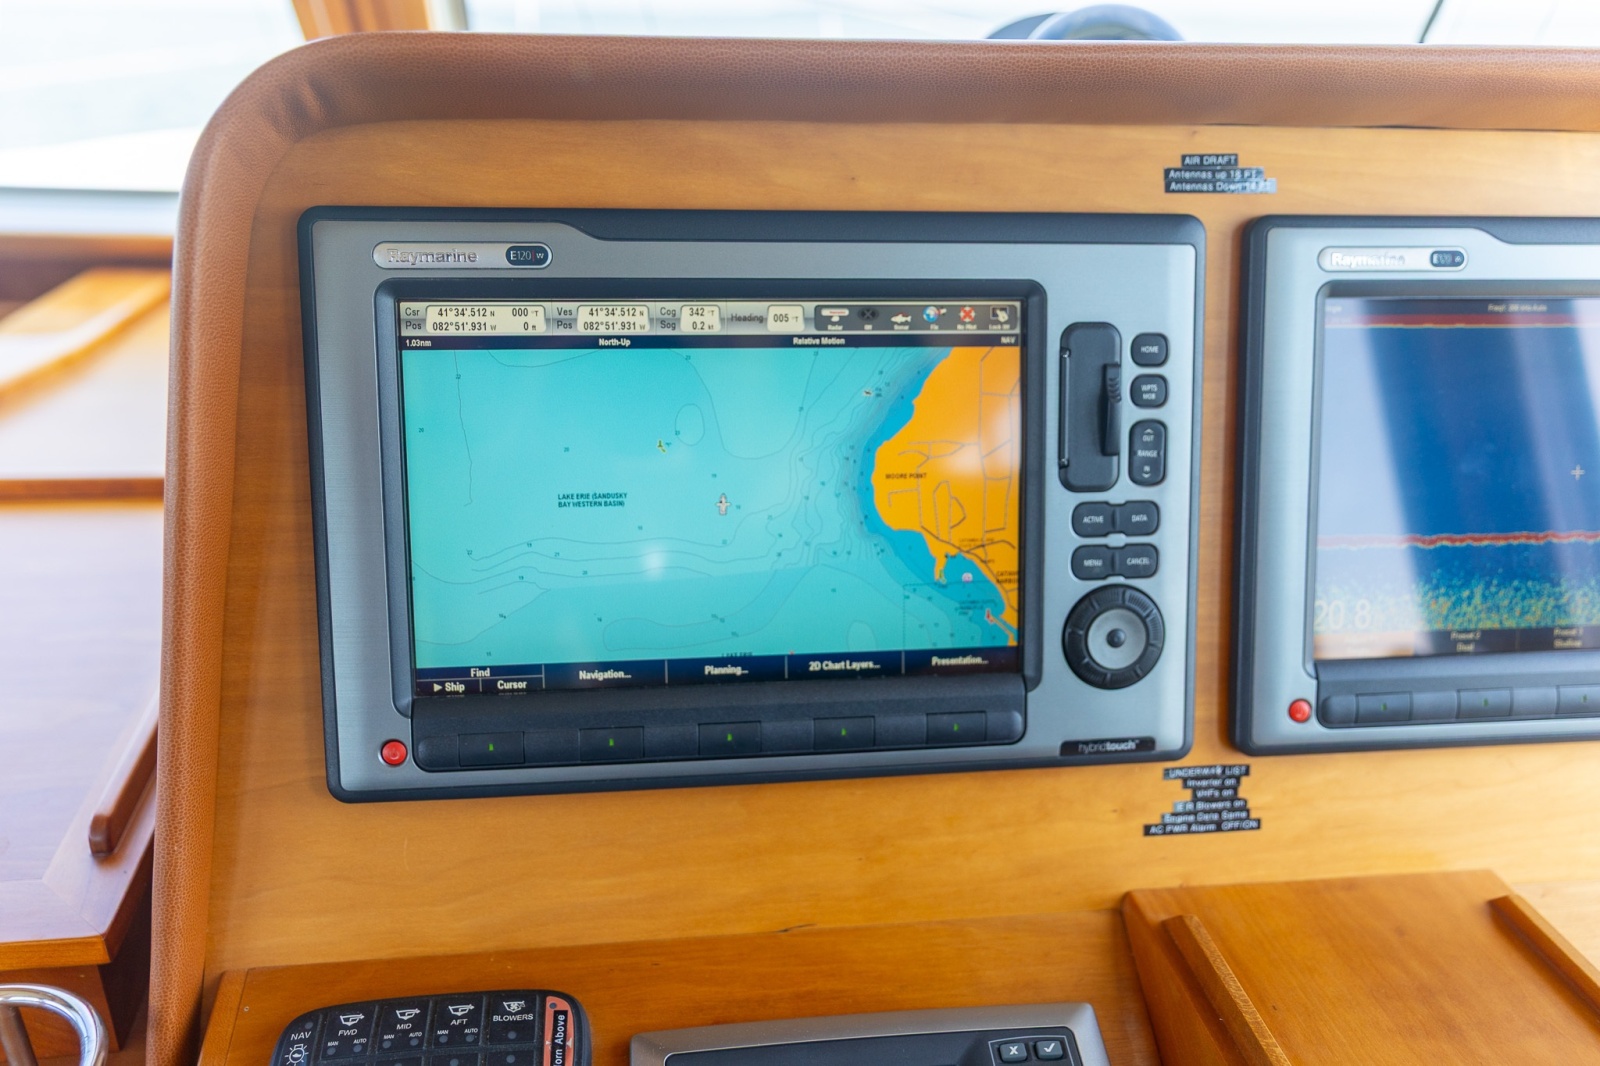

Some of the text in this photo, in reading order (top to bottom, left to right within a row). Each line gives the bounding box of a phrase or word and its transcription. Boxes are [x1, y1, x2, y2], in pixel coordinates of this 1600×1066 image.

[1184, 154, 1236, 166] AIR DRAFT
[1168, 170, 1212, 179] Antennas
[1170, 182, 1214, 191] Antennas
[387, 249, 478, 266] Raymarine
[405, 307, 420, 316] Csr
[512, 308, 528, 317] 000
[556, 306, 572, 316] Ves
[660, 306, 676, 317] Cog
[689, 307, 704, 316] 342
[731, 313, 764, 324] Heading
[773, 314, 790, 322] 005
[406, 320, 422, 330] Pos
[556, 320, 572, 329] Pos
[660, 320, 676, 330] Sog
[692, 321, 705, 330] 0.2
[406, 339, 432, 347] 1.03nm
[598, 338, 631, 348] North-Up
[792, 336, 846, 346] Relative Motion
[1141, 346, 1158, 354] HOME
[1083, 516, 1104, 524] ACTIVE
[1131, 514, 1148, 522] DATA
[1126, 557, 1150, 566] CANCEL
[822, 660, 845, 670] Chart
[470, 668, 490, 677] Find
[445, 682, 465, 692] Ship
[497, 680, 527, 690] Cursor
[492, 1014, 534, 1022] BLOWERS
[338, 1029, 358, 1037] FWD
[554, 1014, 566, 1046] Above
[290, 1031, 312, 1040] NAV
